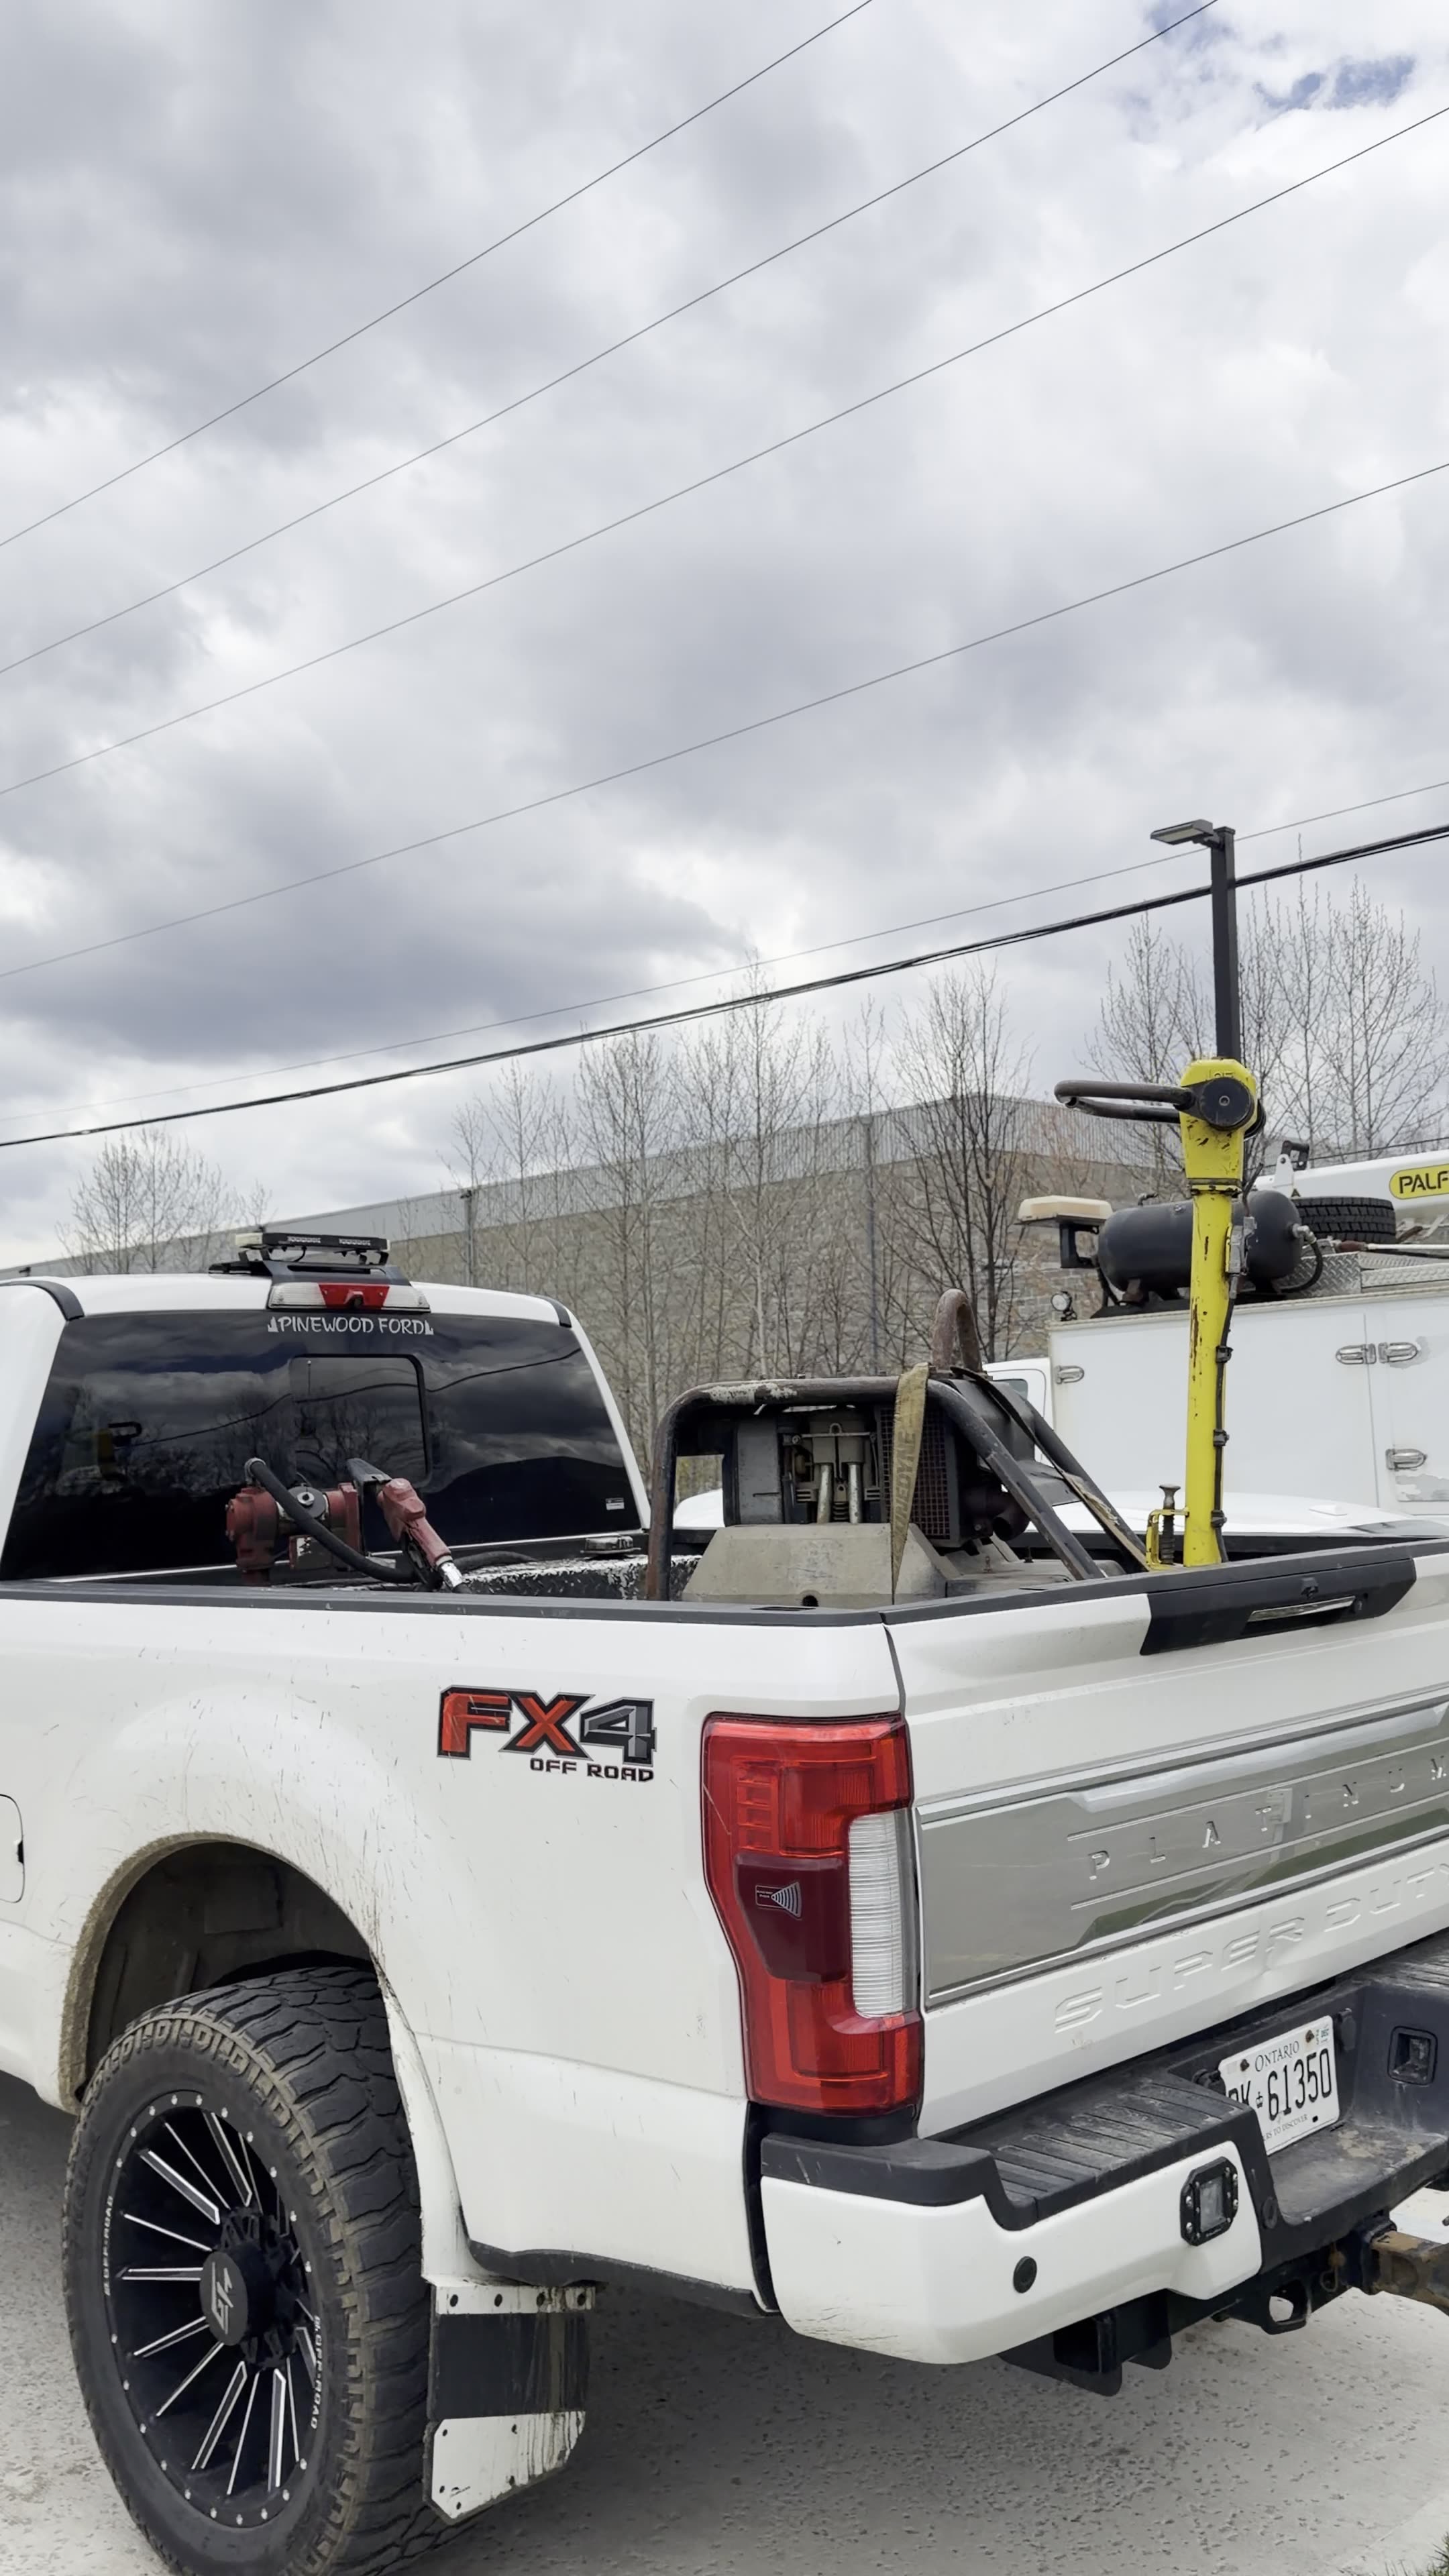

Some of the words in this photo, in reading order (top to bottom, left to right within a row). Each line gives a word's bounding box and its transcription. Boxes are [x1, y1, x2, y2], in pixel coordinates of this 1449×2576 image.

[277, 1316, 374, 1332] PINEWOOD
[378, 1317, 425, 1335] FORD
[436, 1684, 657, 1768] FX4
[529, 1758, 577, 1774] OFF
[587, 1763, 655, 1783] ROAD
[1089, 1755, 1448, 1880] PLATINUM
[1054, 1916, 1305, 2034] SUPER
[1254, 2041, 1300, 2072] ONTARIO
[1268, 2048, 1332, 2122] 61350
